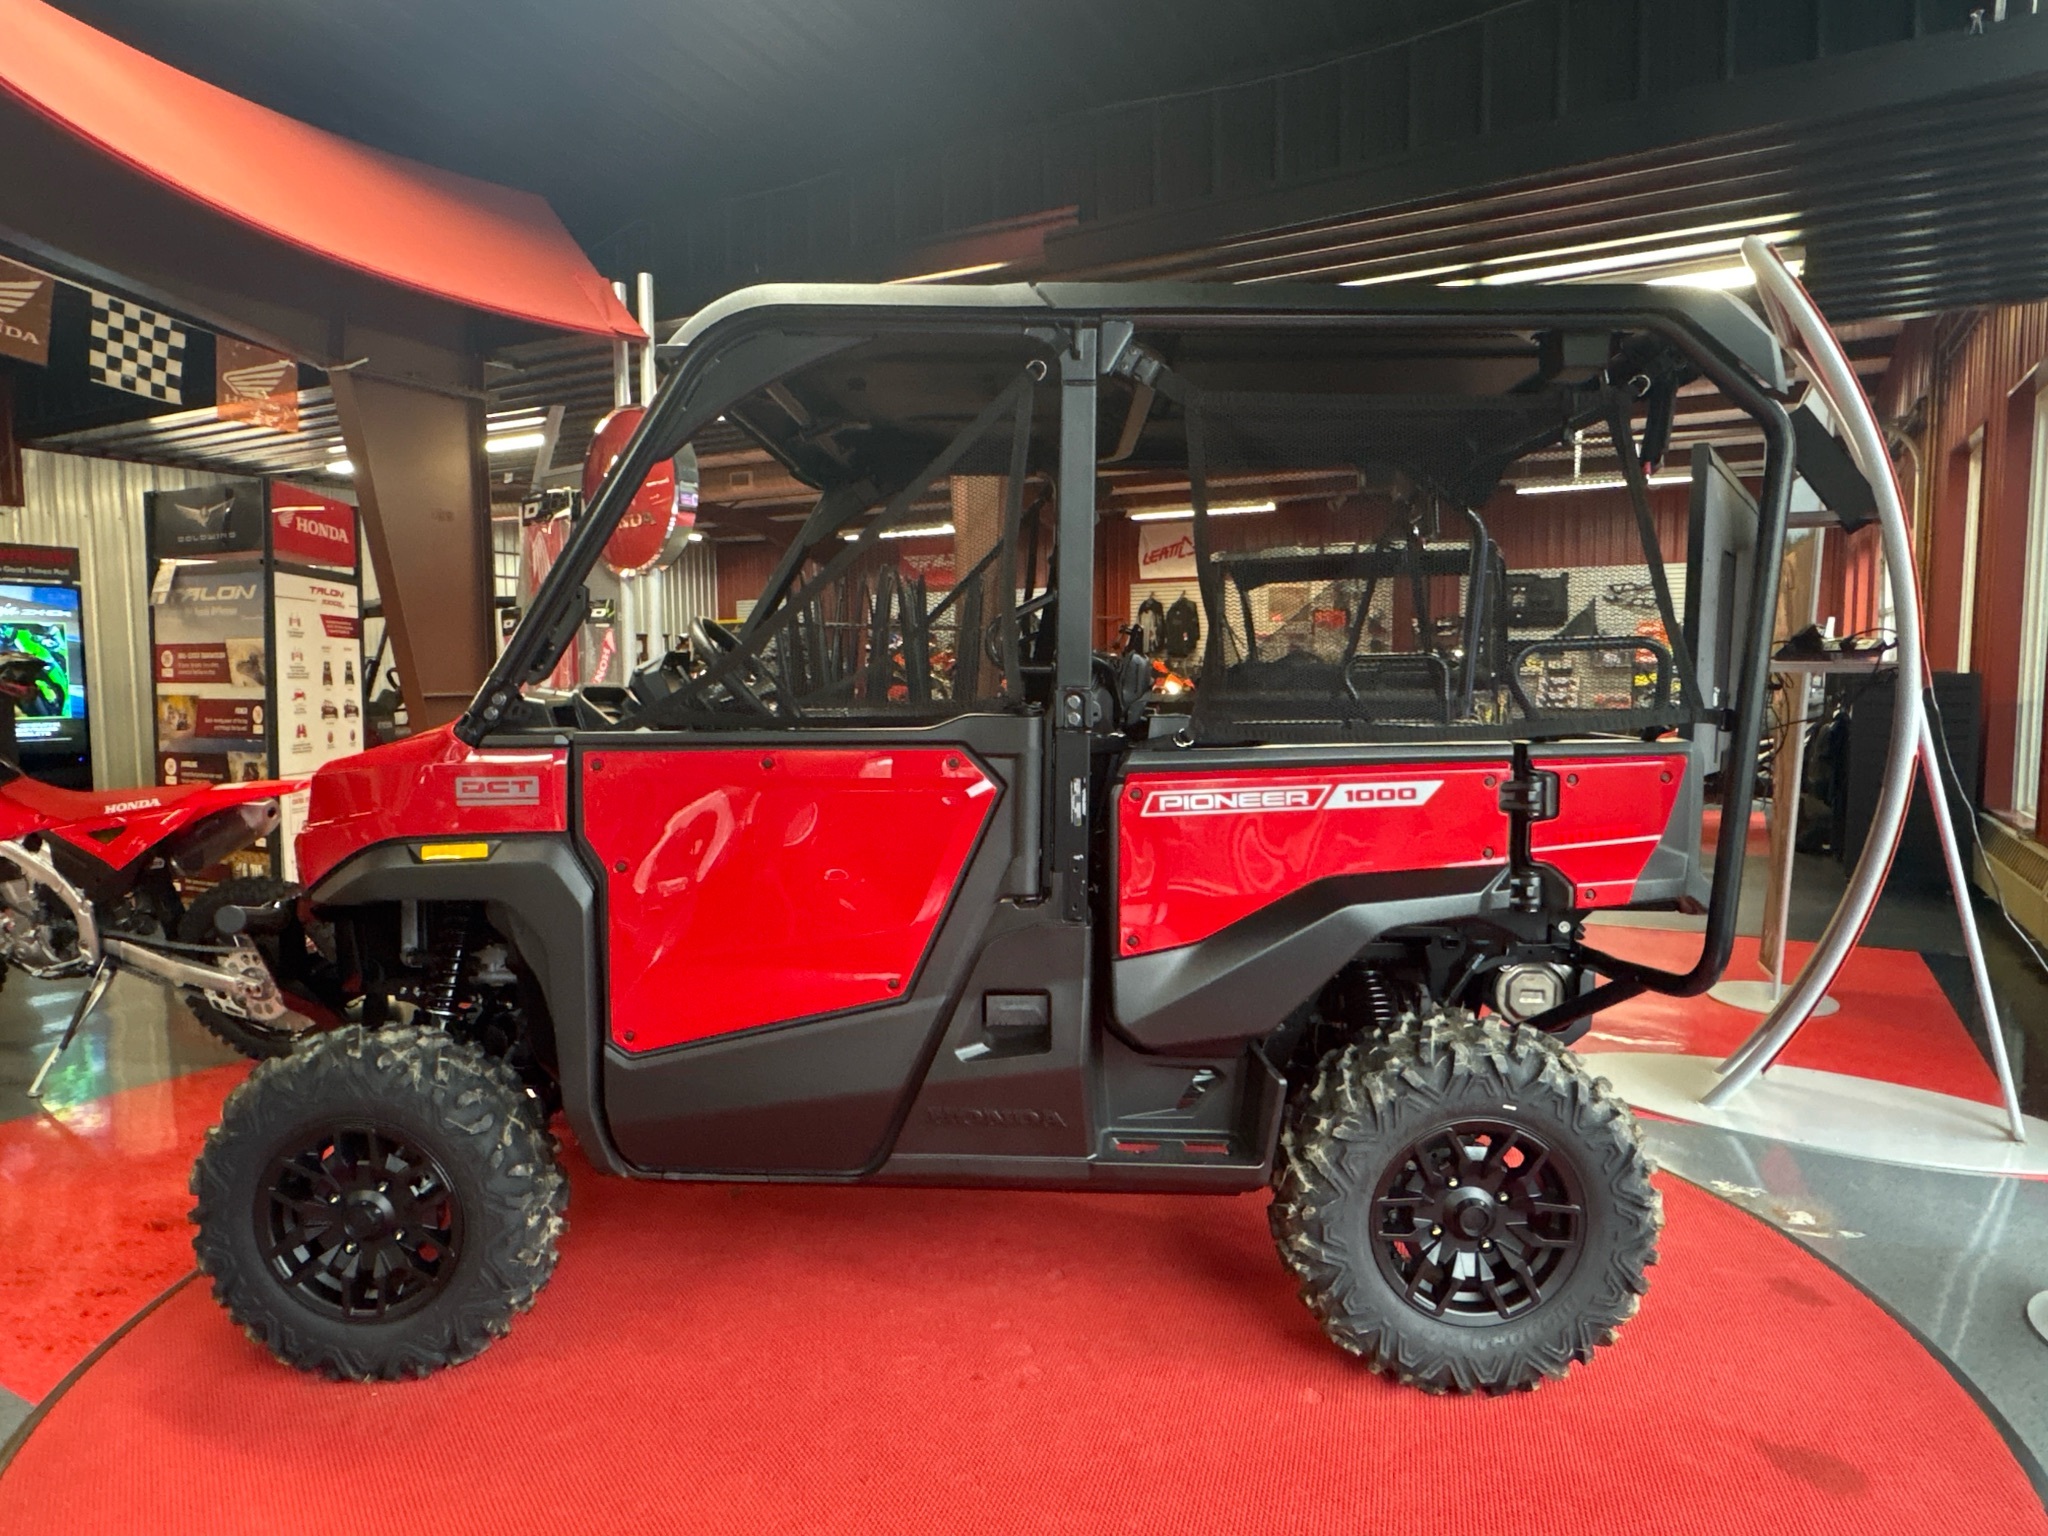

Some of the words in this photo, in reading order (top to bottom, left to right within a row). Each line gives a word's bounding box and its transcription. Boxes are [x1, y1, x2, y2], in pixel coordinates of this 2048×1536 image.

[296, 516, 349, 544] HONDA
[309, 586, 344, 599] TALON
[462, 780, 533, 794] DCT
[104, 798, 162, 815] HONDA
[1159, 790, 1309, 811] PIONEER
[1345, 787, 1416, 802] 1000
